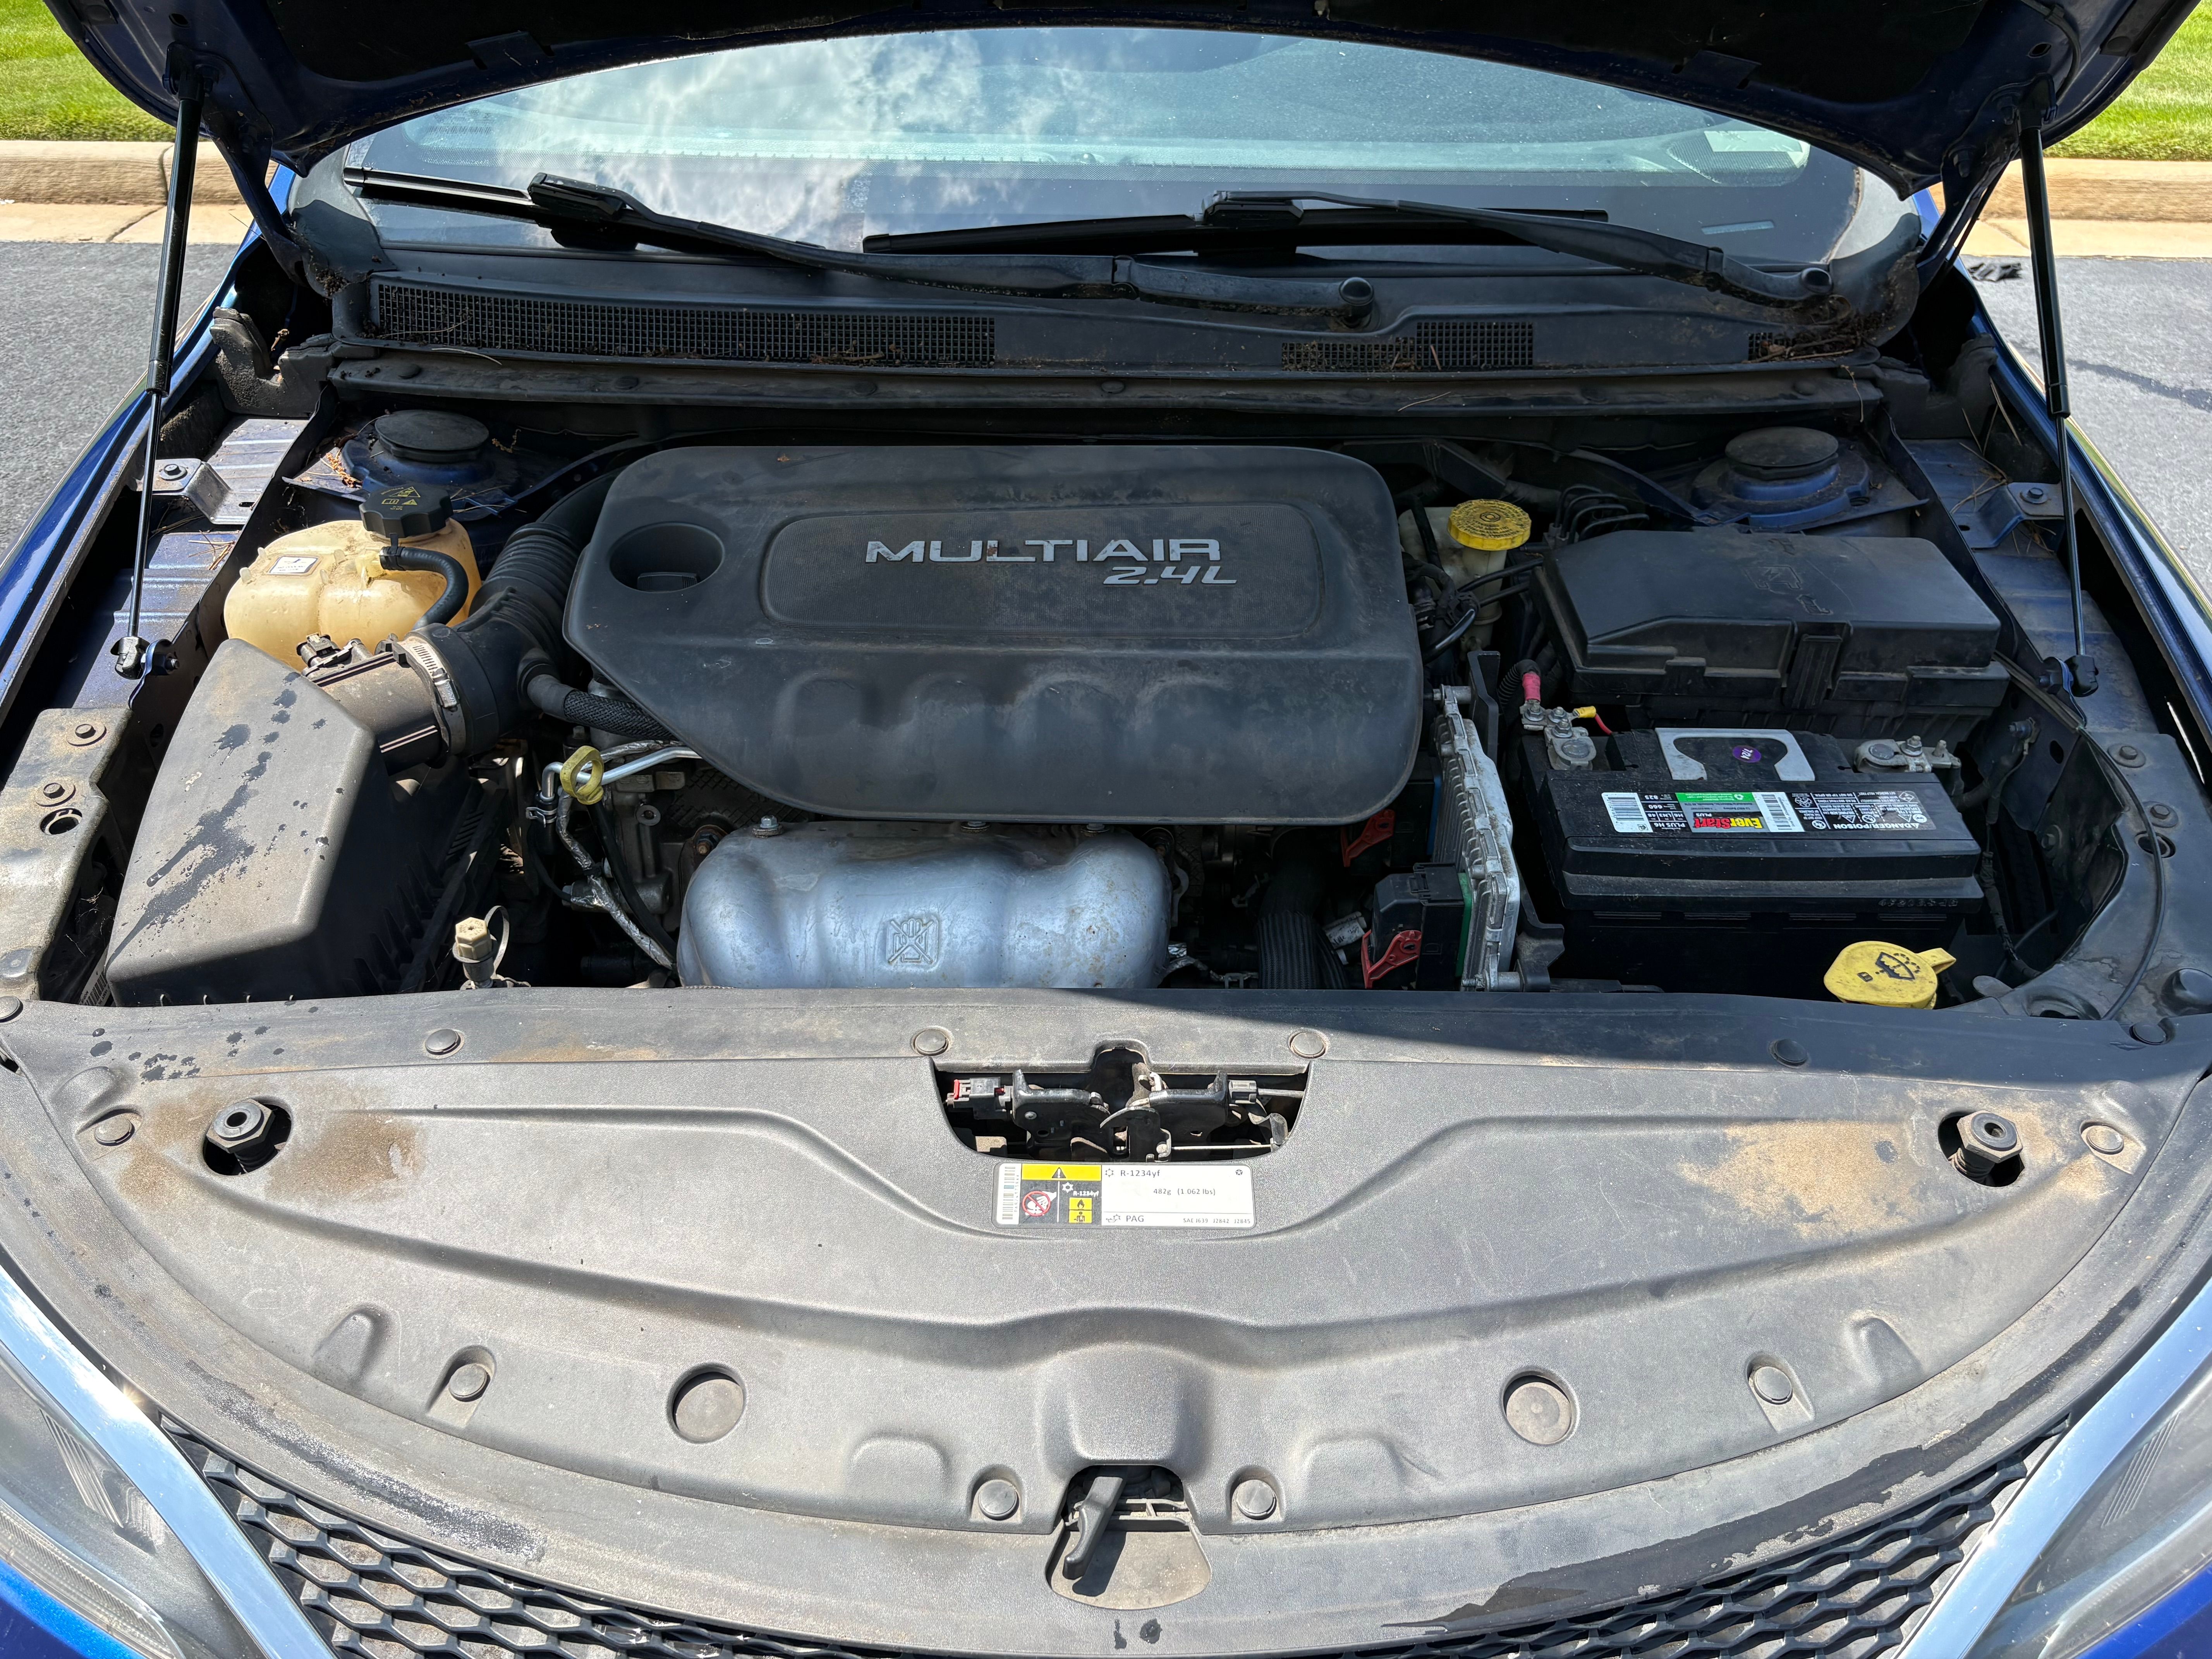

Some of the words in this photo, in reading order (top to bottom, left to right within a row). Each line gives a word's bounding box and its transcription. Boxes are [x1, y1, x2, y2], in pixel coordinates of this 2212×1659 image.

[865, 539, 1221, 563] MULTIAIR
[1103, 565, 1237, 584] 2.4L
[1694, 817, 1763, 829] EverStart
[1120, 1169, 1160, 1177] R-1234yf
[1202, 1188, 1216, 1196] lbs)
